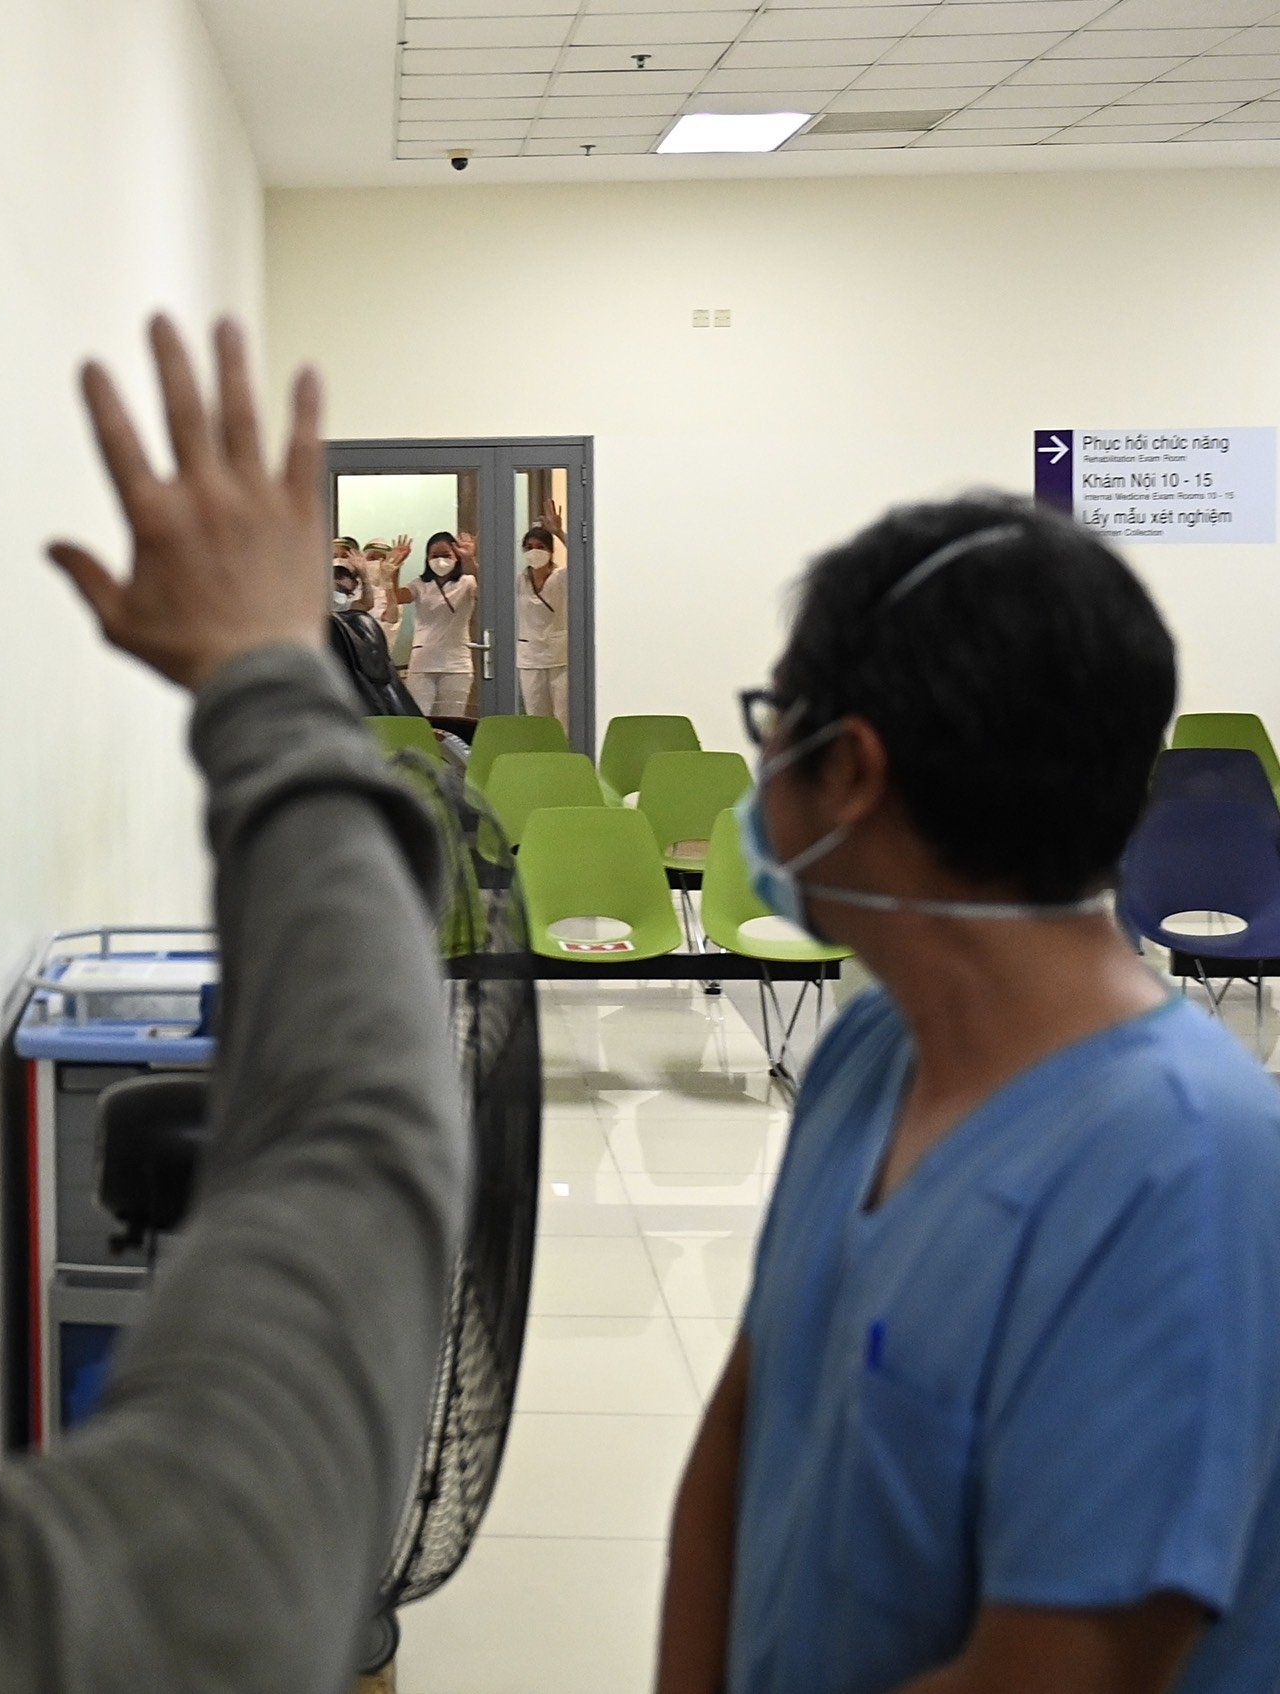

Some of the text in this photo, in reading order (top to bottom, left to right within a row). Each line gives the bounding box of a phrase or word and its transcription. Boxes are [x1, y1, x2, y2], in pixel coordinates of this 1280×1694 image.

[1082, 472, 1126, 489] Khám
[1161, 472, 1180, 488] 10
[1195, 471, 1214, 488] 15
